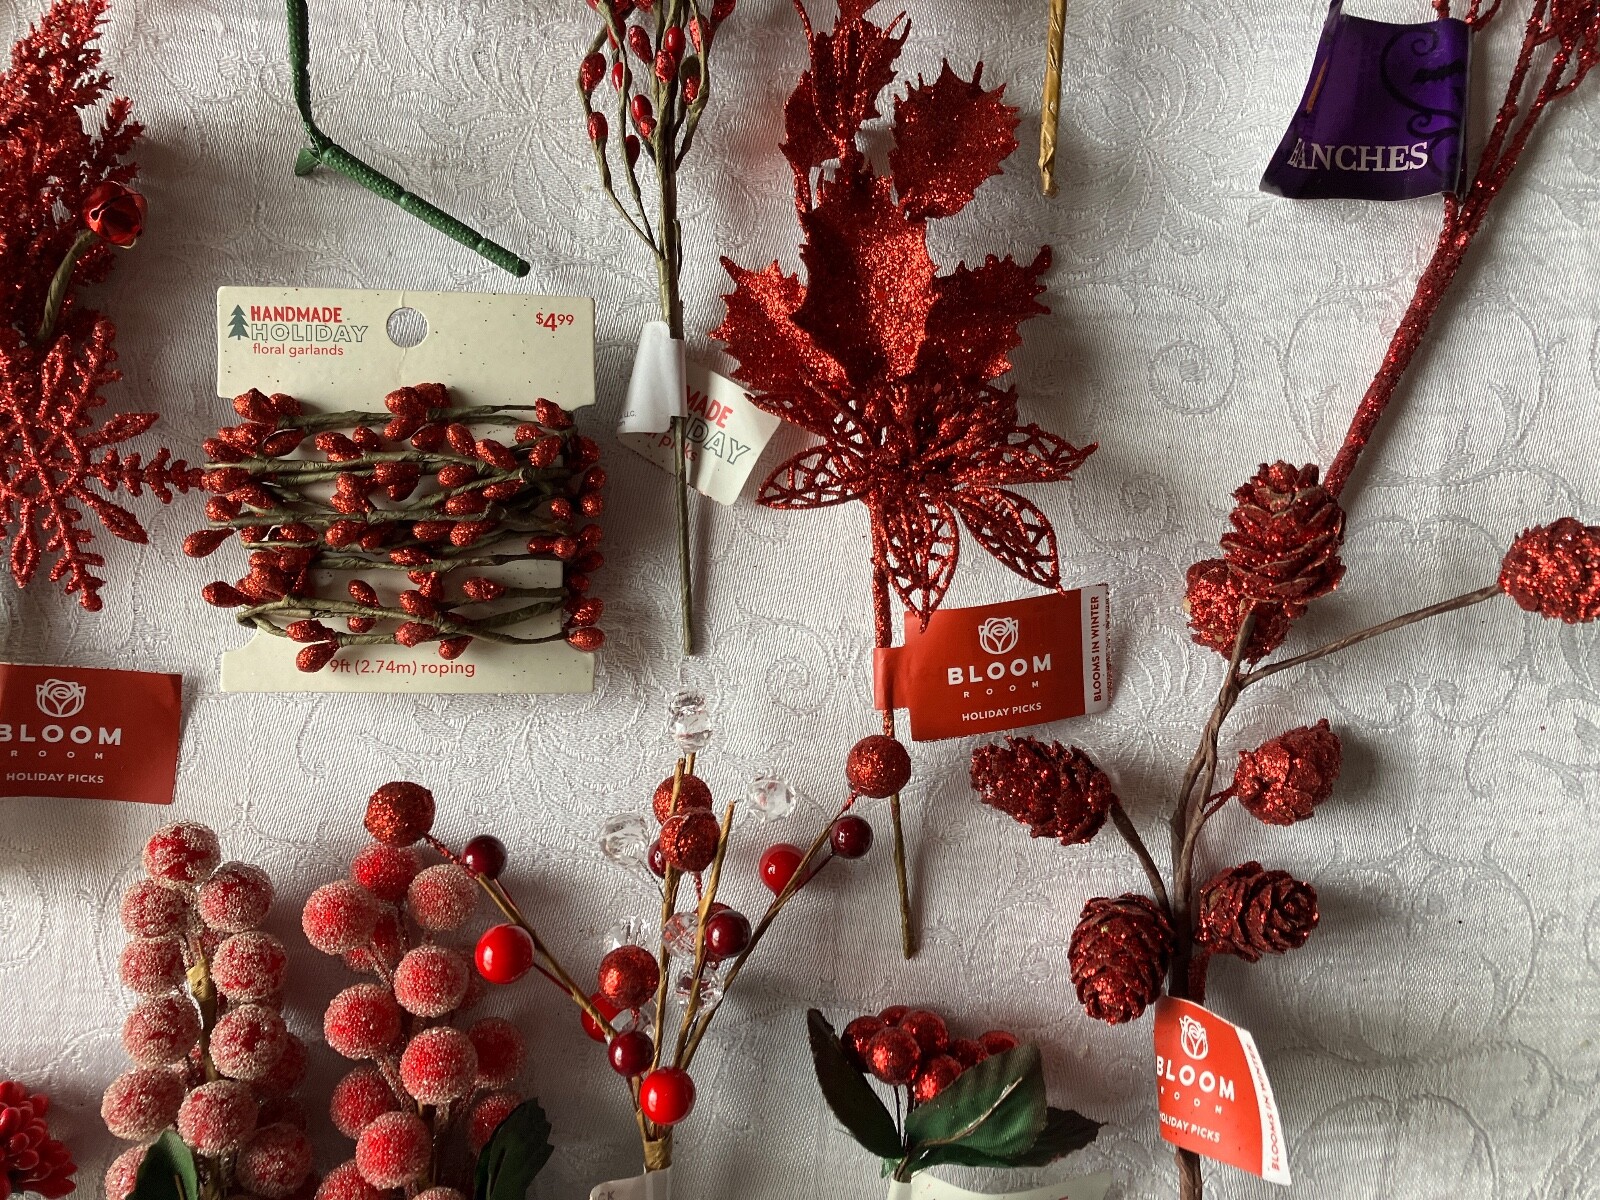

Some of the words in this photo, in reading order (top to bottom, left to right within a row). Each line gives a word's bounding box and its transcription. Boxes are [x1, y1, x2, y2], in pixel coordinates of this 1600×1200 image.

[250, 306, 342, 323] HANDMADE
[251, 323, 368, 342] HOLIDAY
[253, 343, 285, 355] floral
[288, 343, 344, 358] garlands
[686, 414, 751, 465] DAY
[1090, 595, 1100, 640] WINTER
[1091, 640, 1100, 654] IN
[330, 659, 351, 674] 9ft
[354, 659, 418, 677] (2.74m)
[421, 661, 476, 678] roping
[947, 653, 1052, 686] BLOOM
[1091, 655, 1102, 702] BLOOMS
[963, 681, 1039, 698] ROOM
[961, 706, 1010, 722] HOLIDAY
[1011, 702, 1042, 716] PICKS
[0, 723, 122, 746] BLOOM
[10, 750, 104, 760] ROOM
[6, 772, 64, 782] HOLIDAY
[67, 773, 104, 784] PICKS
[1156, 1055, 1236, 1103] BLOOM
[1190, 1123, 1221, 1143] PICKS
